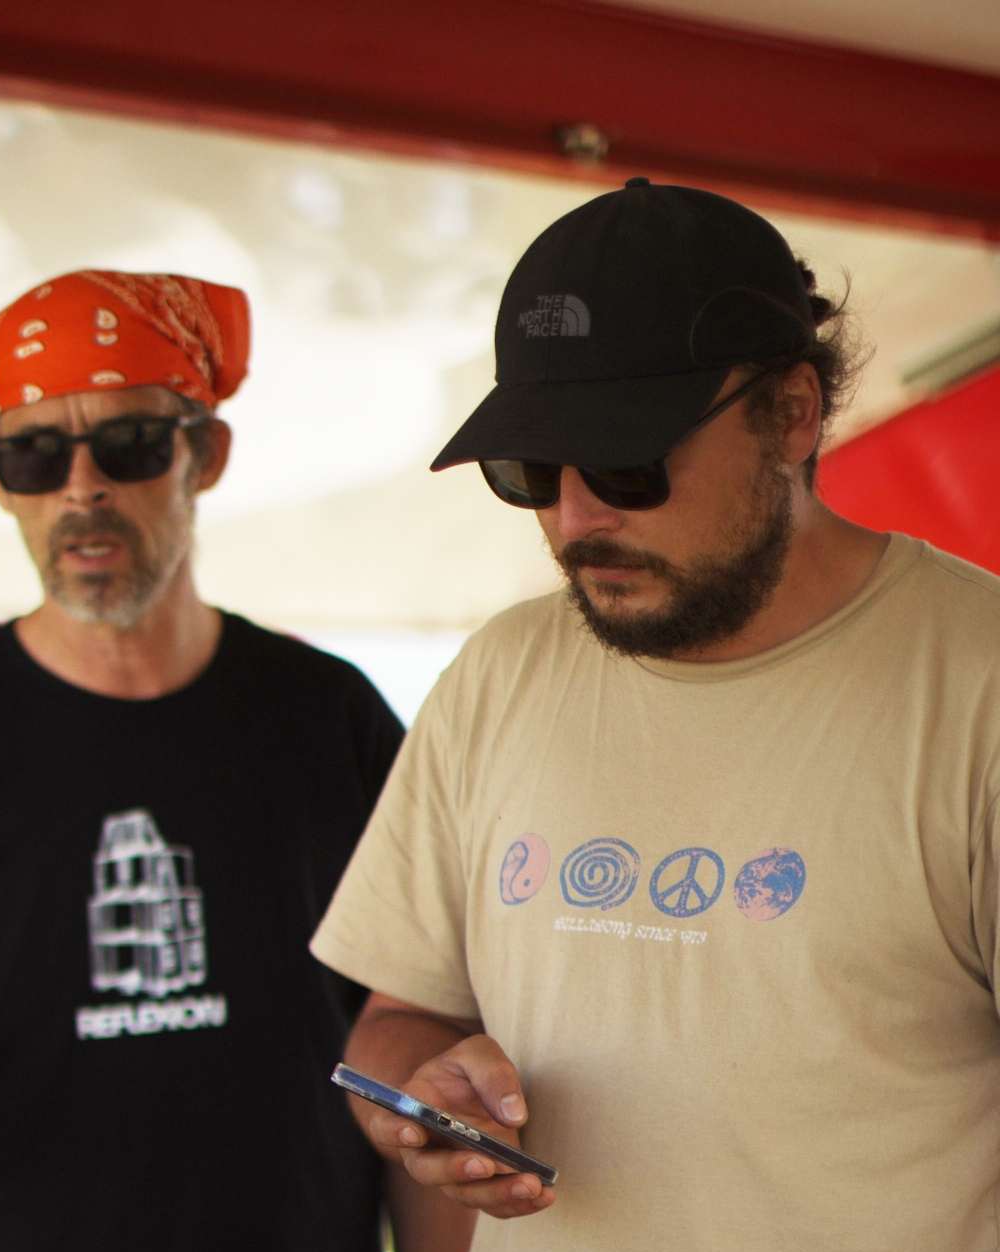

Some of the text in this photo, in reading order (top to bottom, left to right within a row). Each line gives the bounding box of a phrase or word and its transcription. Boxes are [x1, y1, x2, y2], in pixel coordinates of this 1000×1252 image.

[536, 295, 562, 308] THE
[518, 309, 561, 328] NORTH
[526, 323, 561, 338] FACE
[75, 993, 228, 1040] REFLEXION
